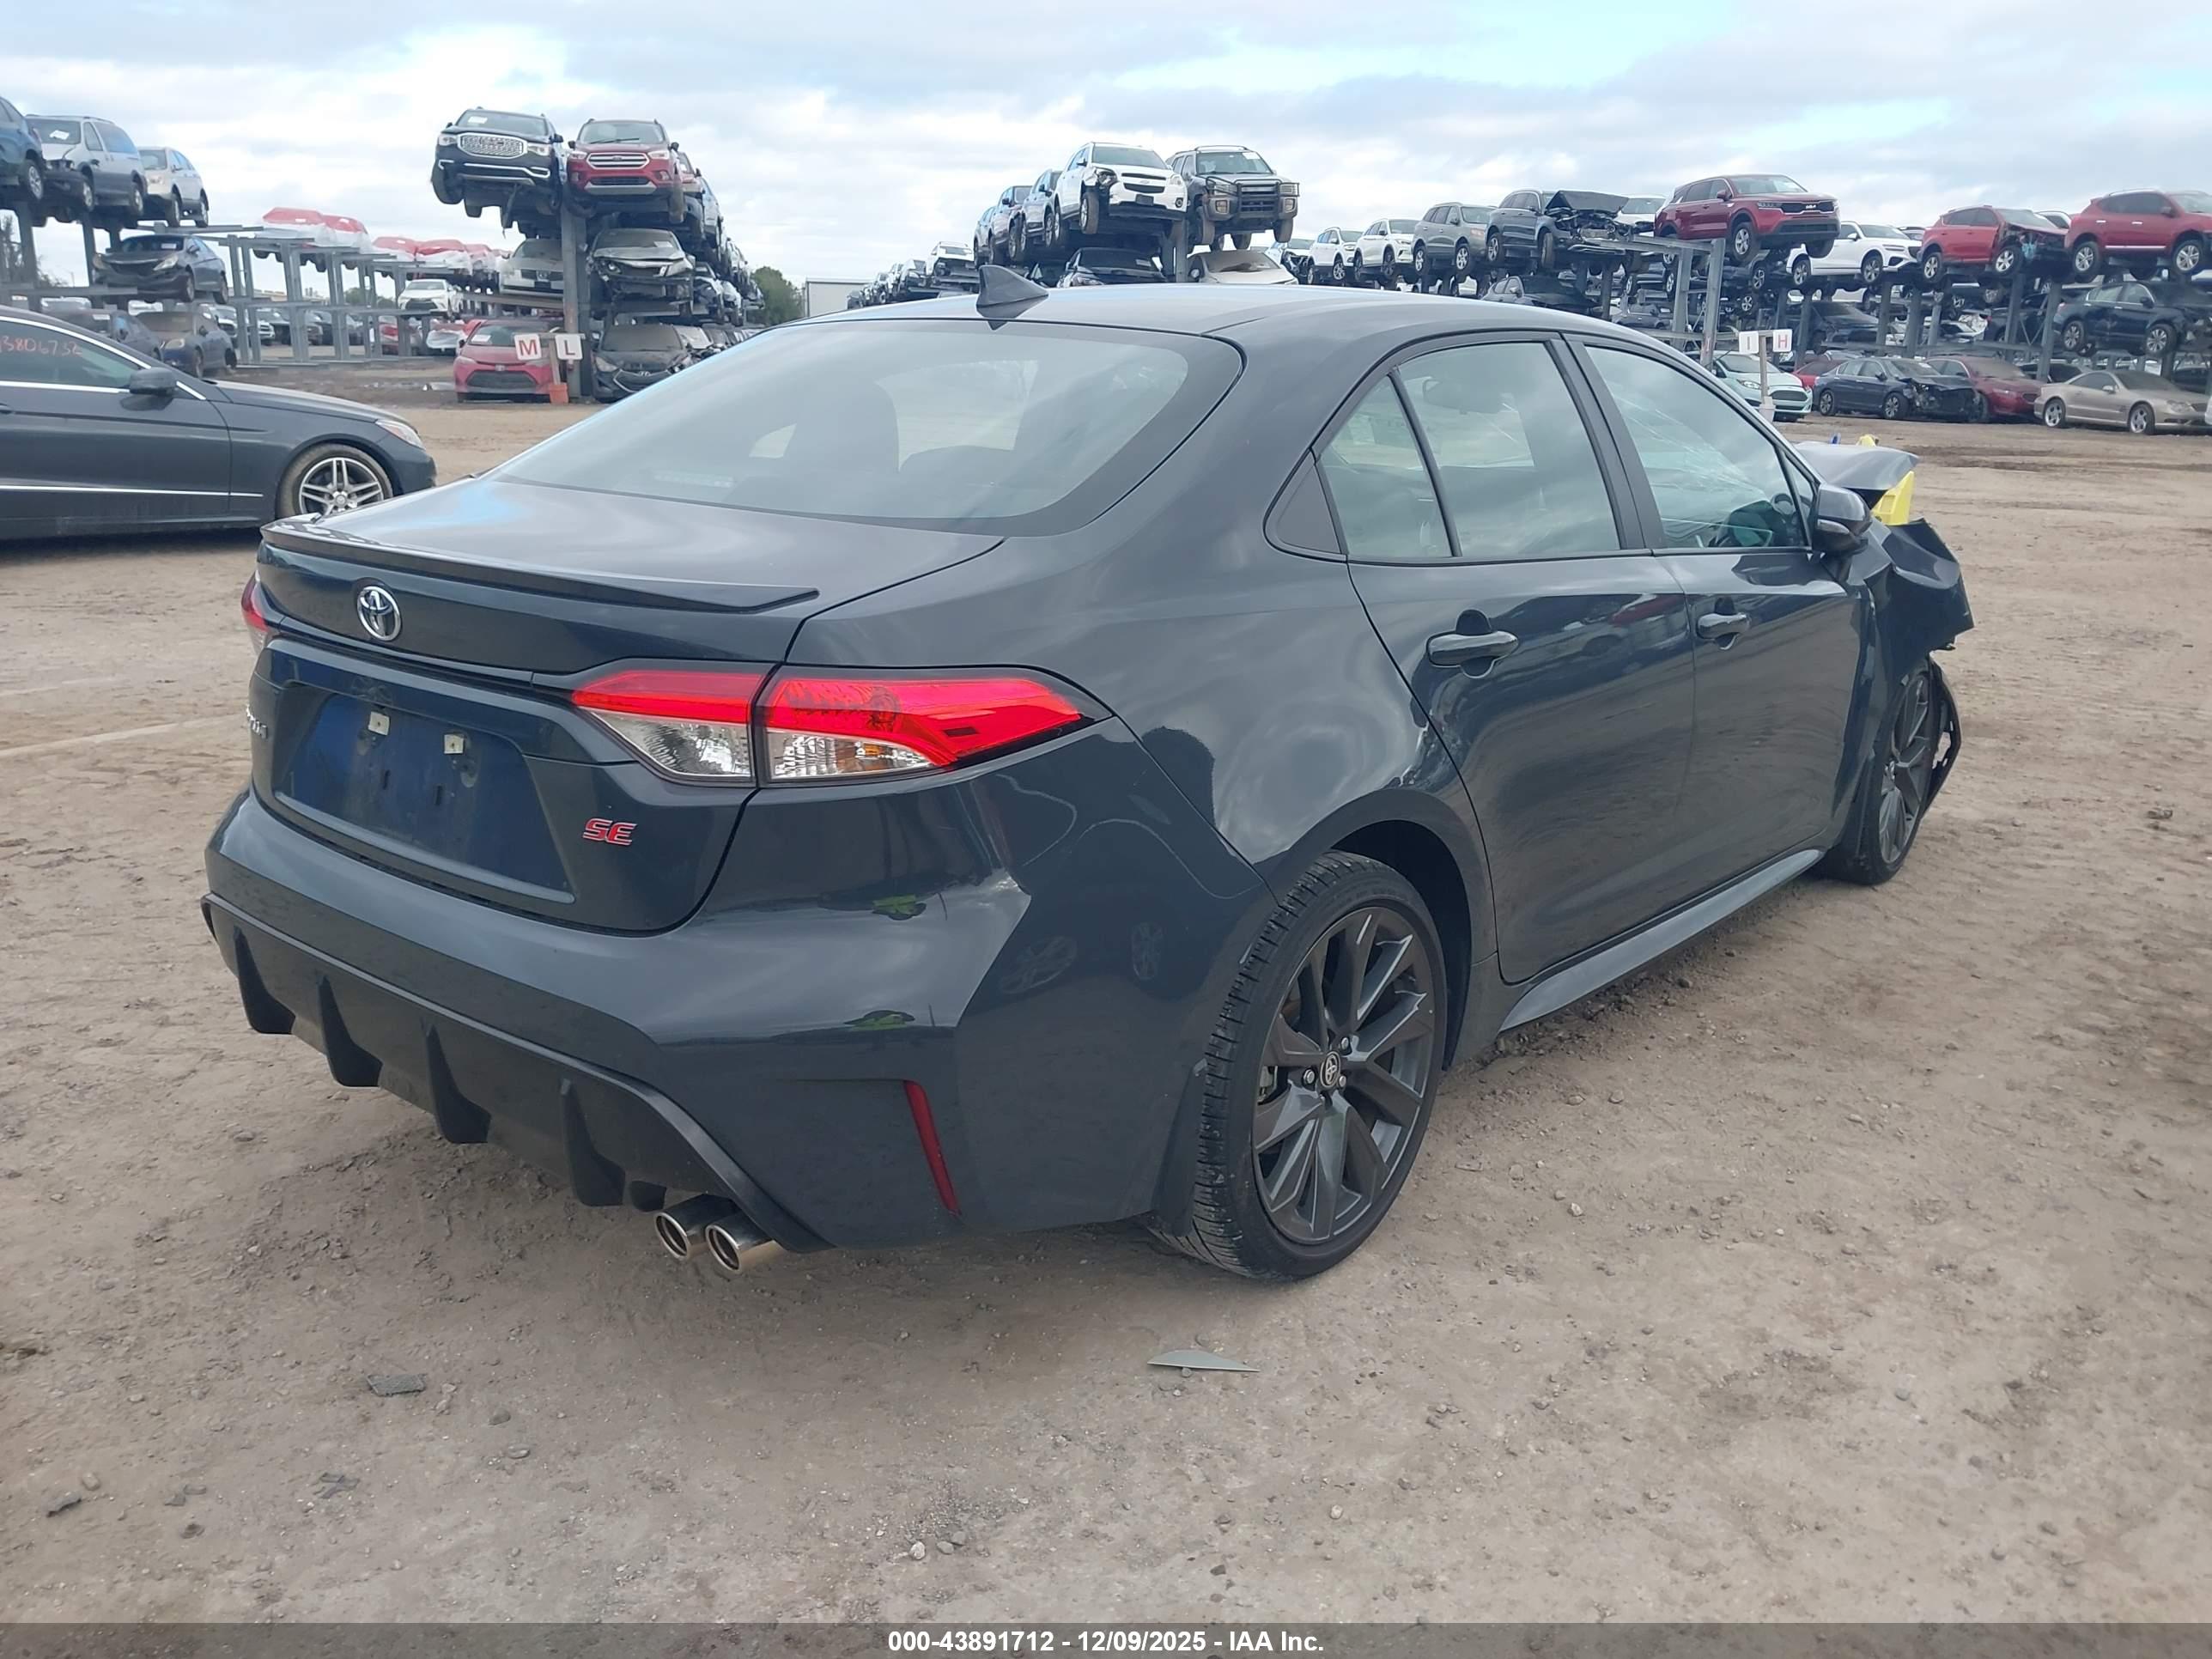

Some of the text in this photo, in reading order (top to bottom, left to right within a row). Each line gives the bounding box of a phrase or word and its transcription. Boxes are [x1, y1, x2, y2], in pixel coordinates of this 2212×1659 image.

[519, 339, 538, 356] M
[564, 339, 576, 356] L
[1778, 334, 1788, 349] H
[582, 817, 637, 846] SE
